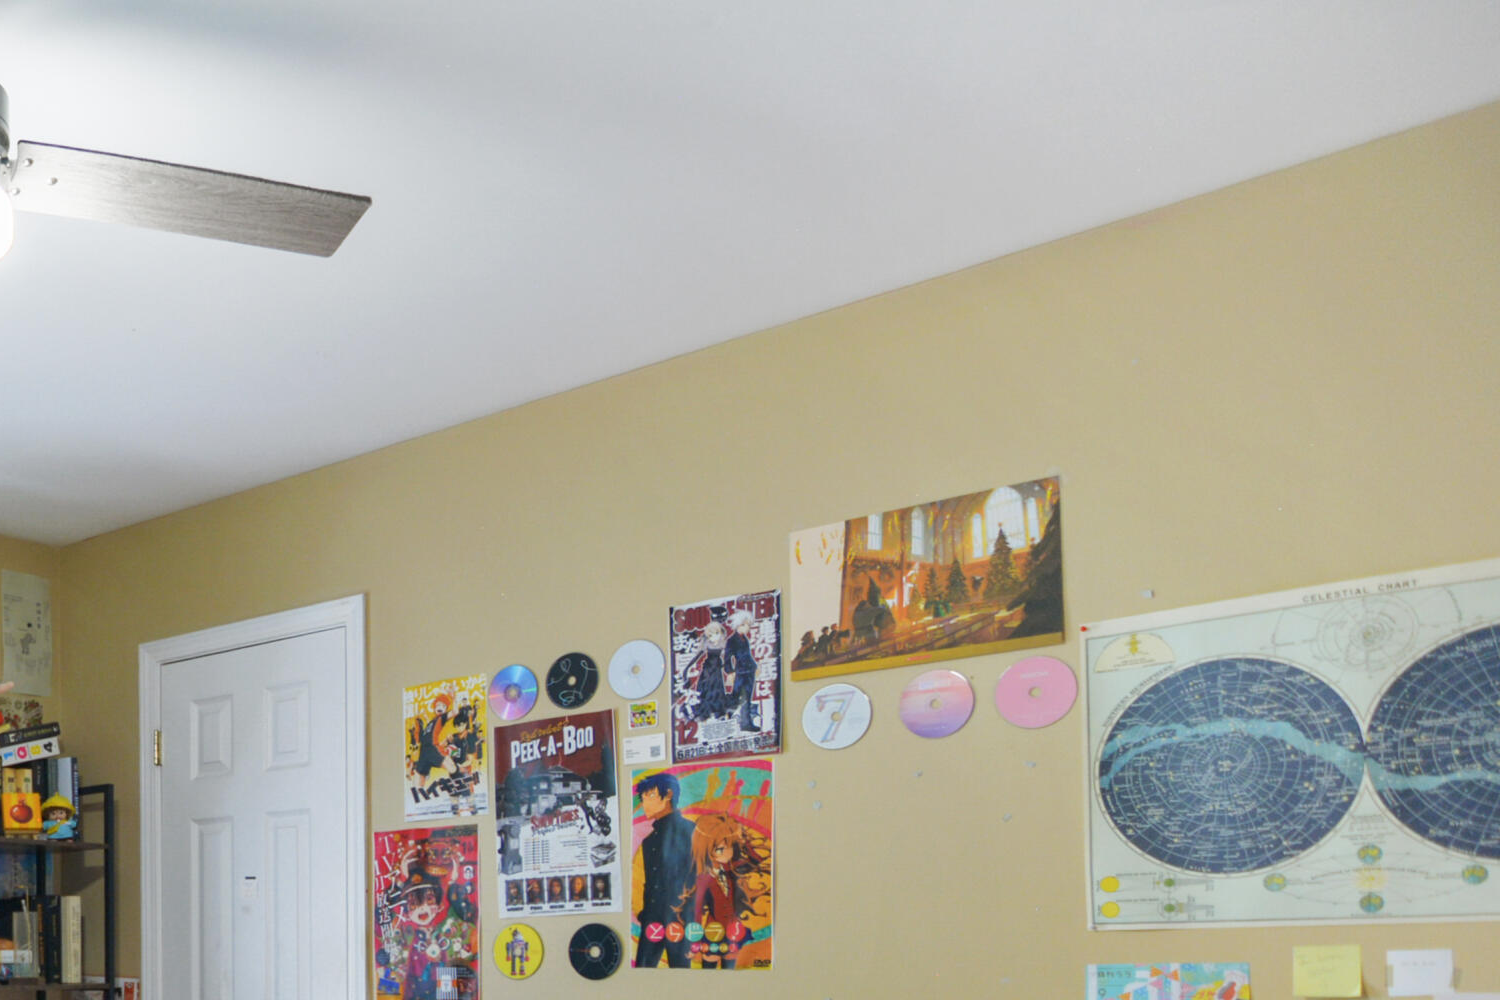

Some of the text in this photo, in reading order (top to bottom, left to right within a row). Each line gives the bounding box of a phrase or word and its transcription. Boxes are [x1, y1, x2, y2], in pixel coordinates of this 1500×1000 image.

[1302, 579, 1418, 602] CELESTIAL CHART
[675, 719, 698, 745] 12
[511, 725, 594, 769] PEEK-A-BOO
[649, 921, 744, 941] とらドラ!
